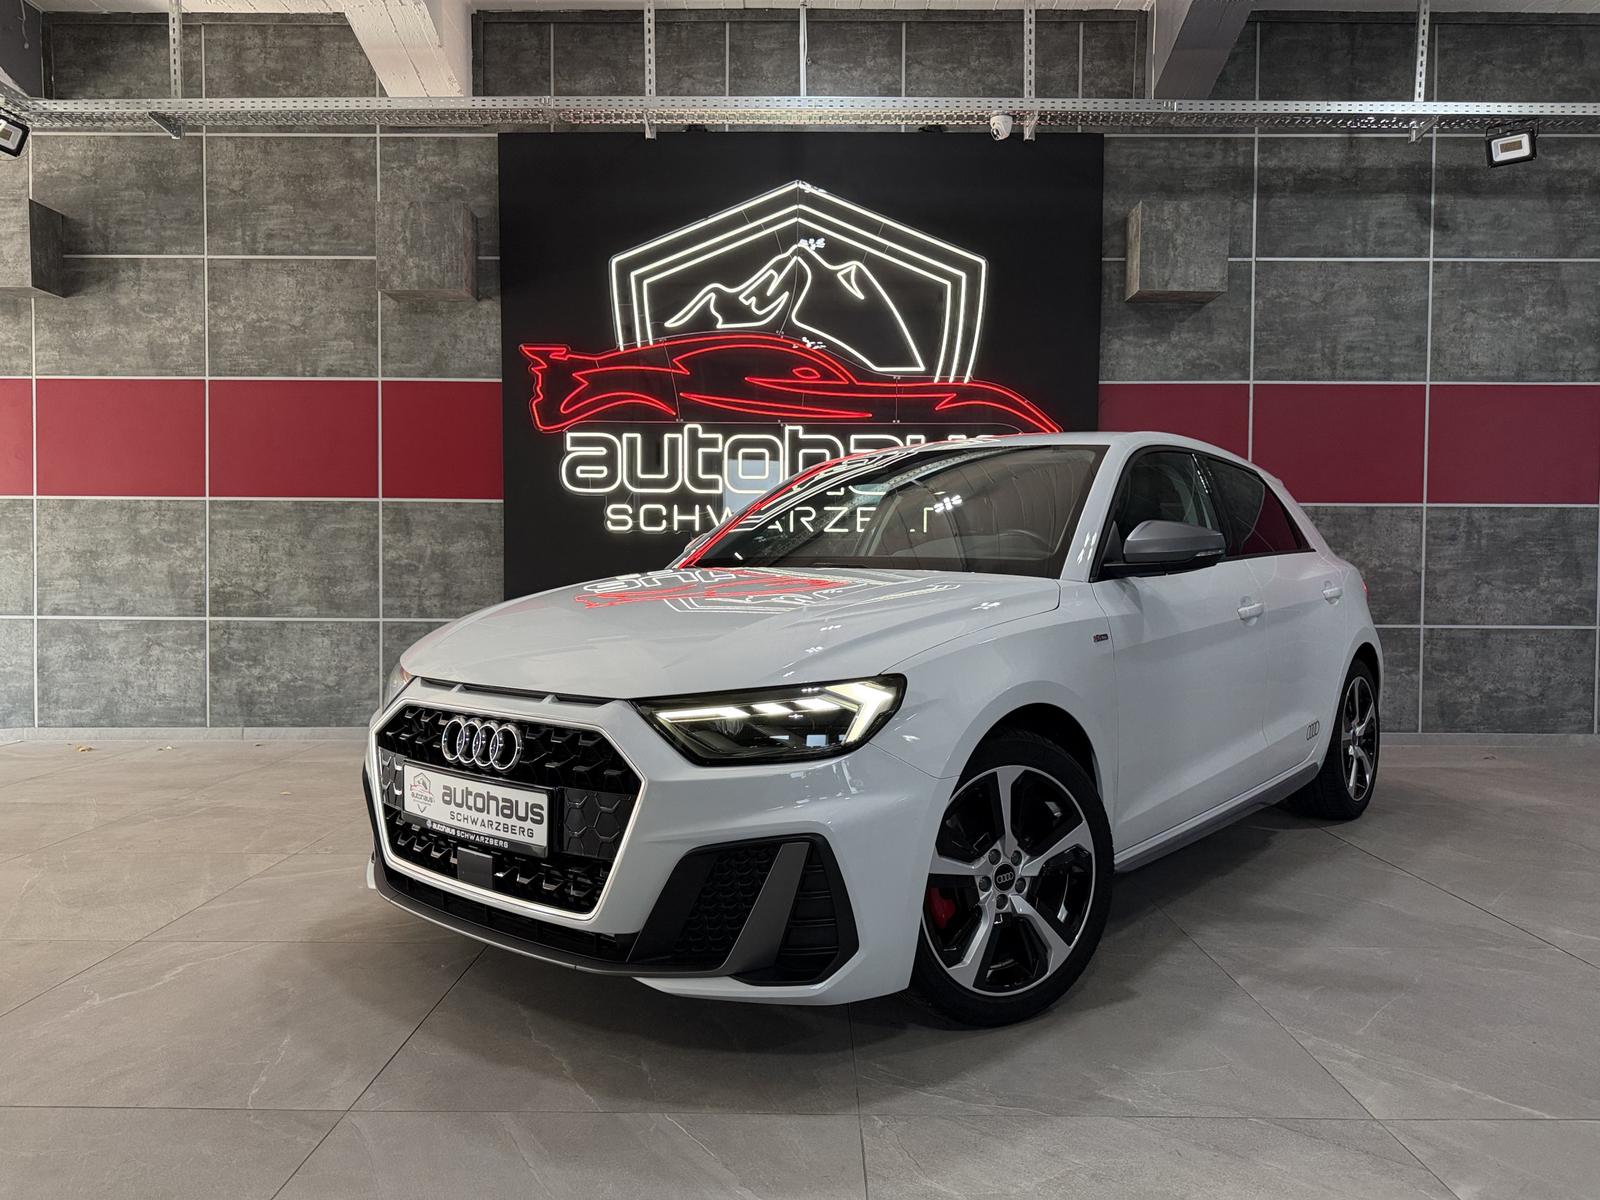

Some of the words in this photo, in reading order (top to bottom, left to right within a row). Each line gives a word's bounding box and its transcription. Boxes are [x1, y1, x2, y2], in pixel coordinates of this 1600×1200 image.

[561, 424, 995, 496] autoh
[441, 784, 545, 825] autohaus
[449, 810, 535, 839] SCHWARZBERG
[456, 829, 509, 849] SCHWARZBERG
